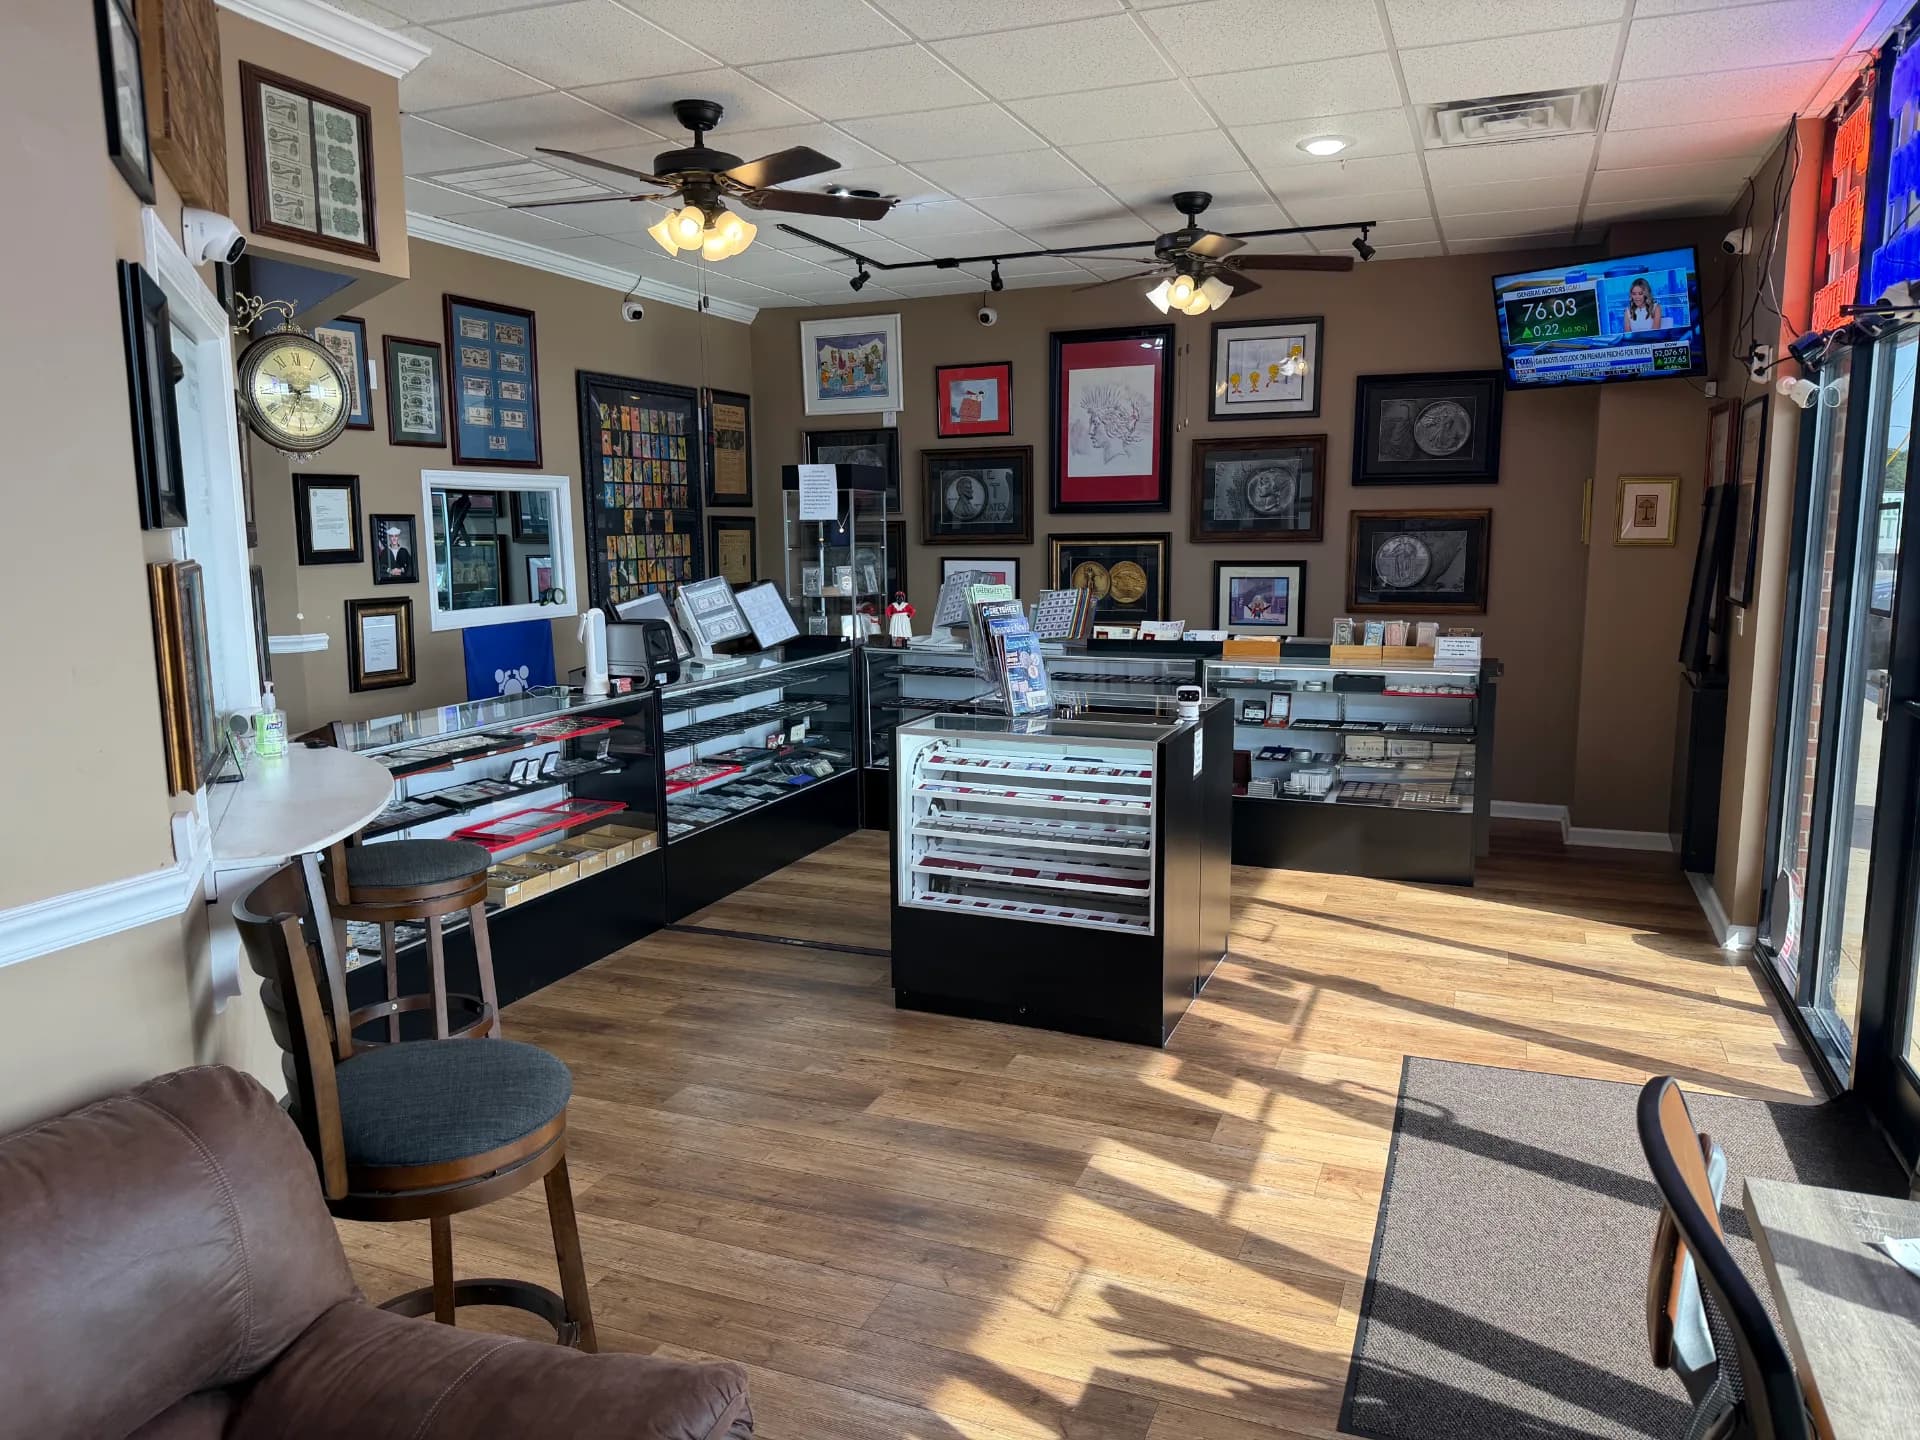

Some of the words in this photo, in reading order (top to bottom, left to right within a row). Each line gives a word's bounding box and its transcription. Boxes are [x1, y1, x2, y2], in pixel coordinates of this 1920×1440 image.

[1517, 288, 1541, 298] GENERAL
[1542, 286, 1566, 296] MOTORS
[1522, 298, 1577, 322] 76.03
[1533, 324, 1560, 337] 0.22
[1634, 347, 1651, 356] TRUCKS
